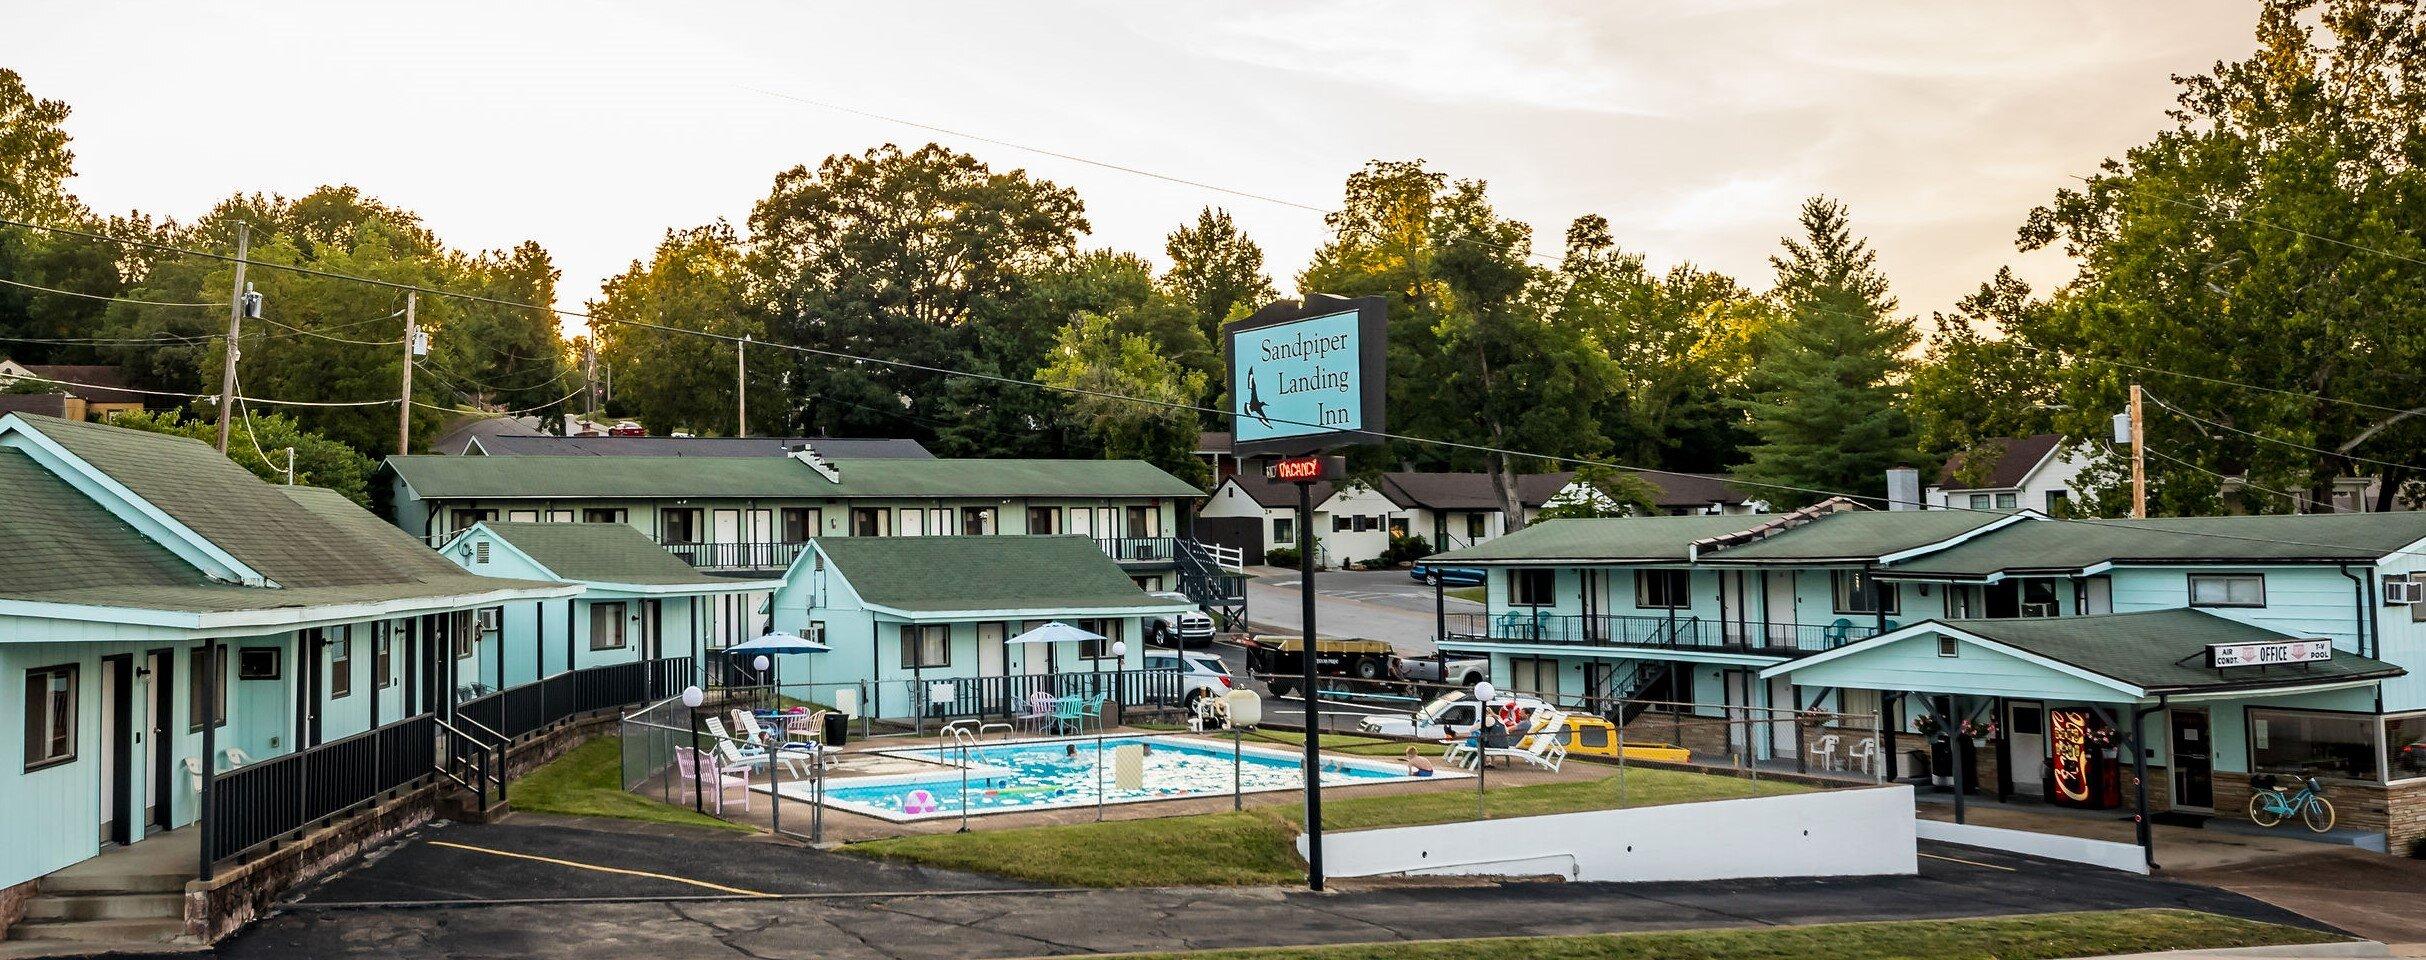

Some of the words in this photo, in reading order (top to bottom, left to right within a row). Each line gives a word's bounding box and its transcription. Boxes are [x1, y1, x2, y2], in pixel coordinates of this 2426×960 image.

[1261, 332, 1348, 361] Sandpiper
[1278, 365, 1349, 395] Landing
[1318, 402, 1350, 426] Inn
[1279, 459, 1317, 478] VACANCY
[2260, 646, 2288, 662] OFFICE
[2310, 651, 2329, 659] POOL
